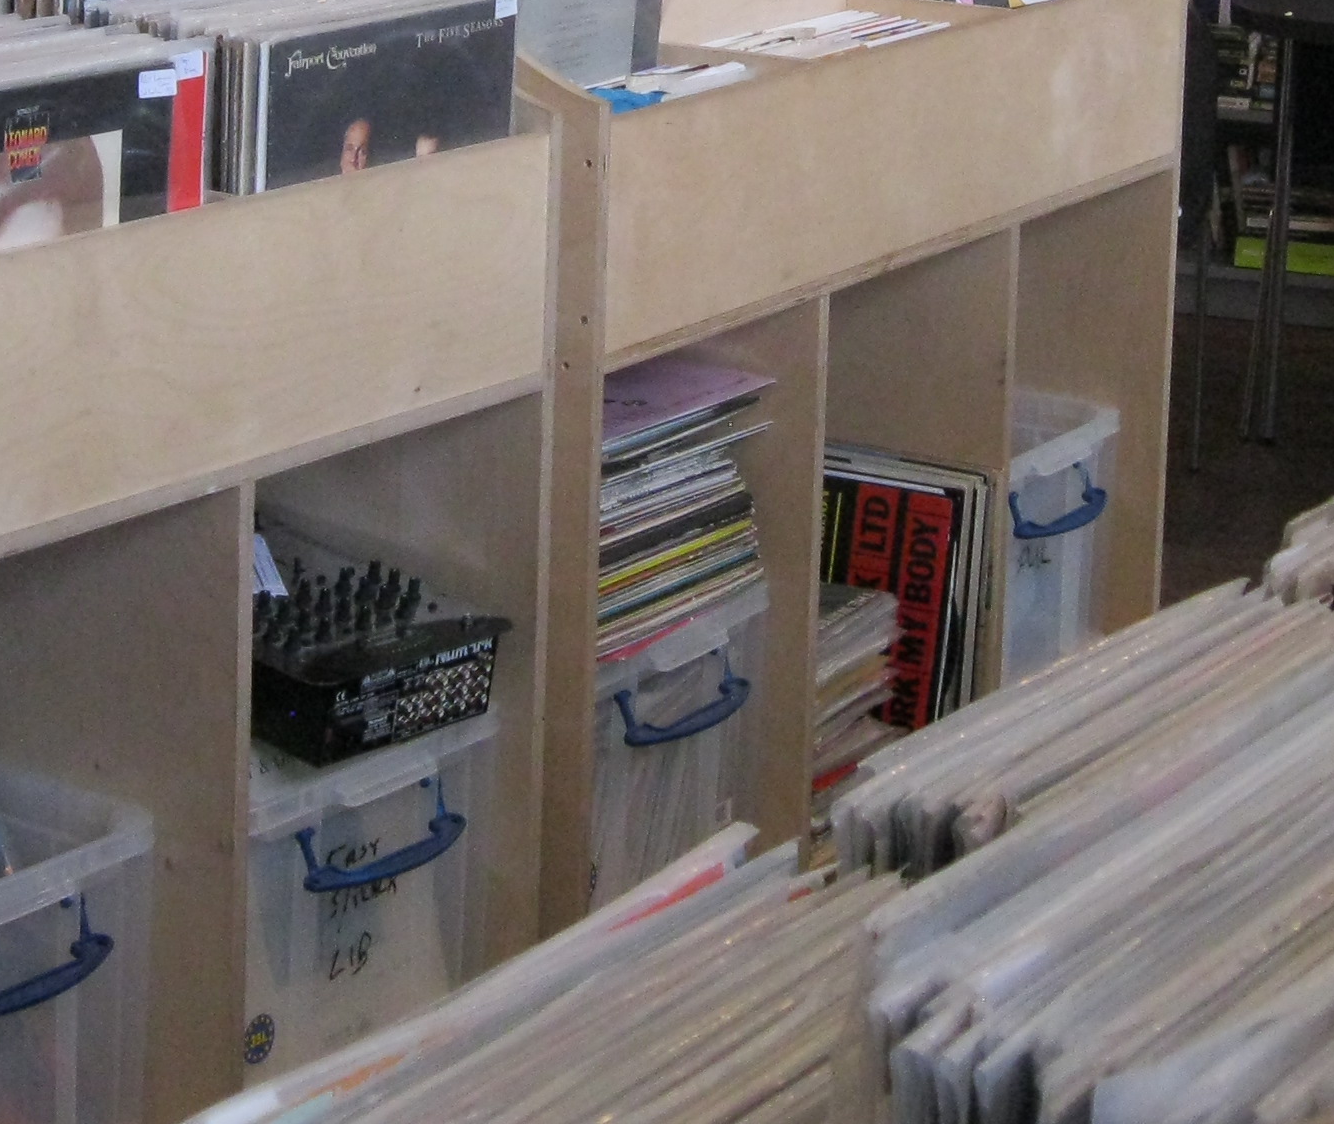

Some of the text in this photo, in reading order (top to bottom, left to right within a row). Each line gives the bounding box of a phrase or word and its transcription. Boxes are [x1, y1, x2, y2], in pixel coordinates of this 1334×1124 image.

[284, 42, 378, 78] Fairport Convention
[4, 126, 48, 148] LEONARD
[861, 495, 891, 557] LTD
[904, 517, 939, 606] BODY
[896, 611, 927, 668] MY
